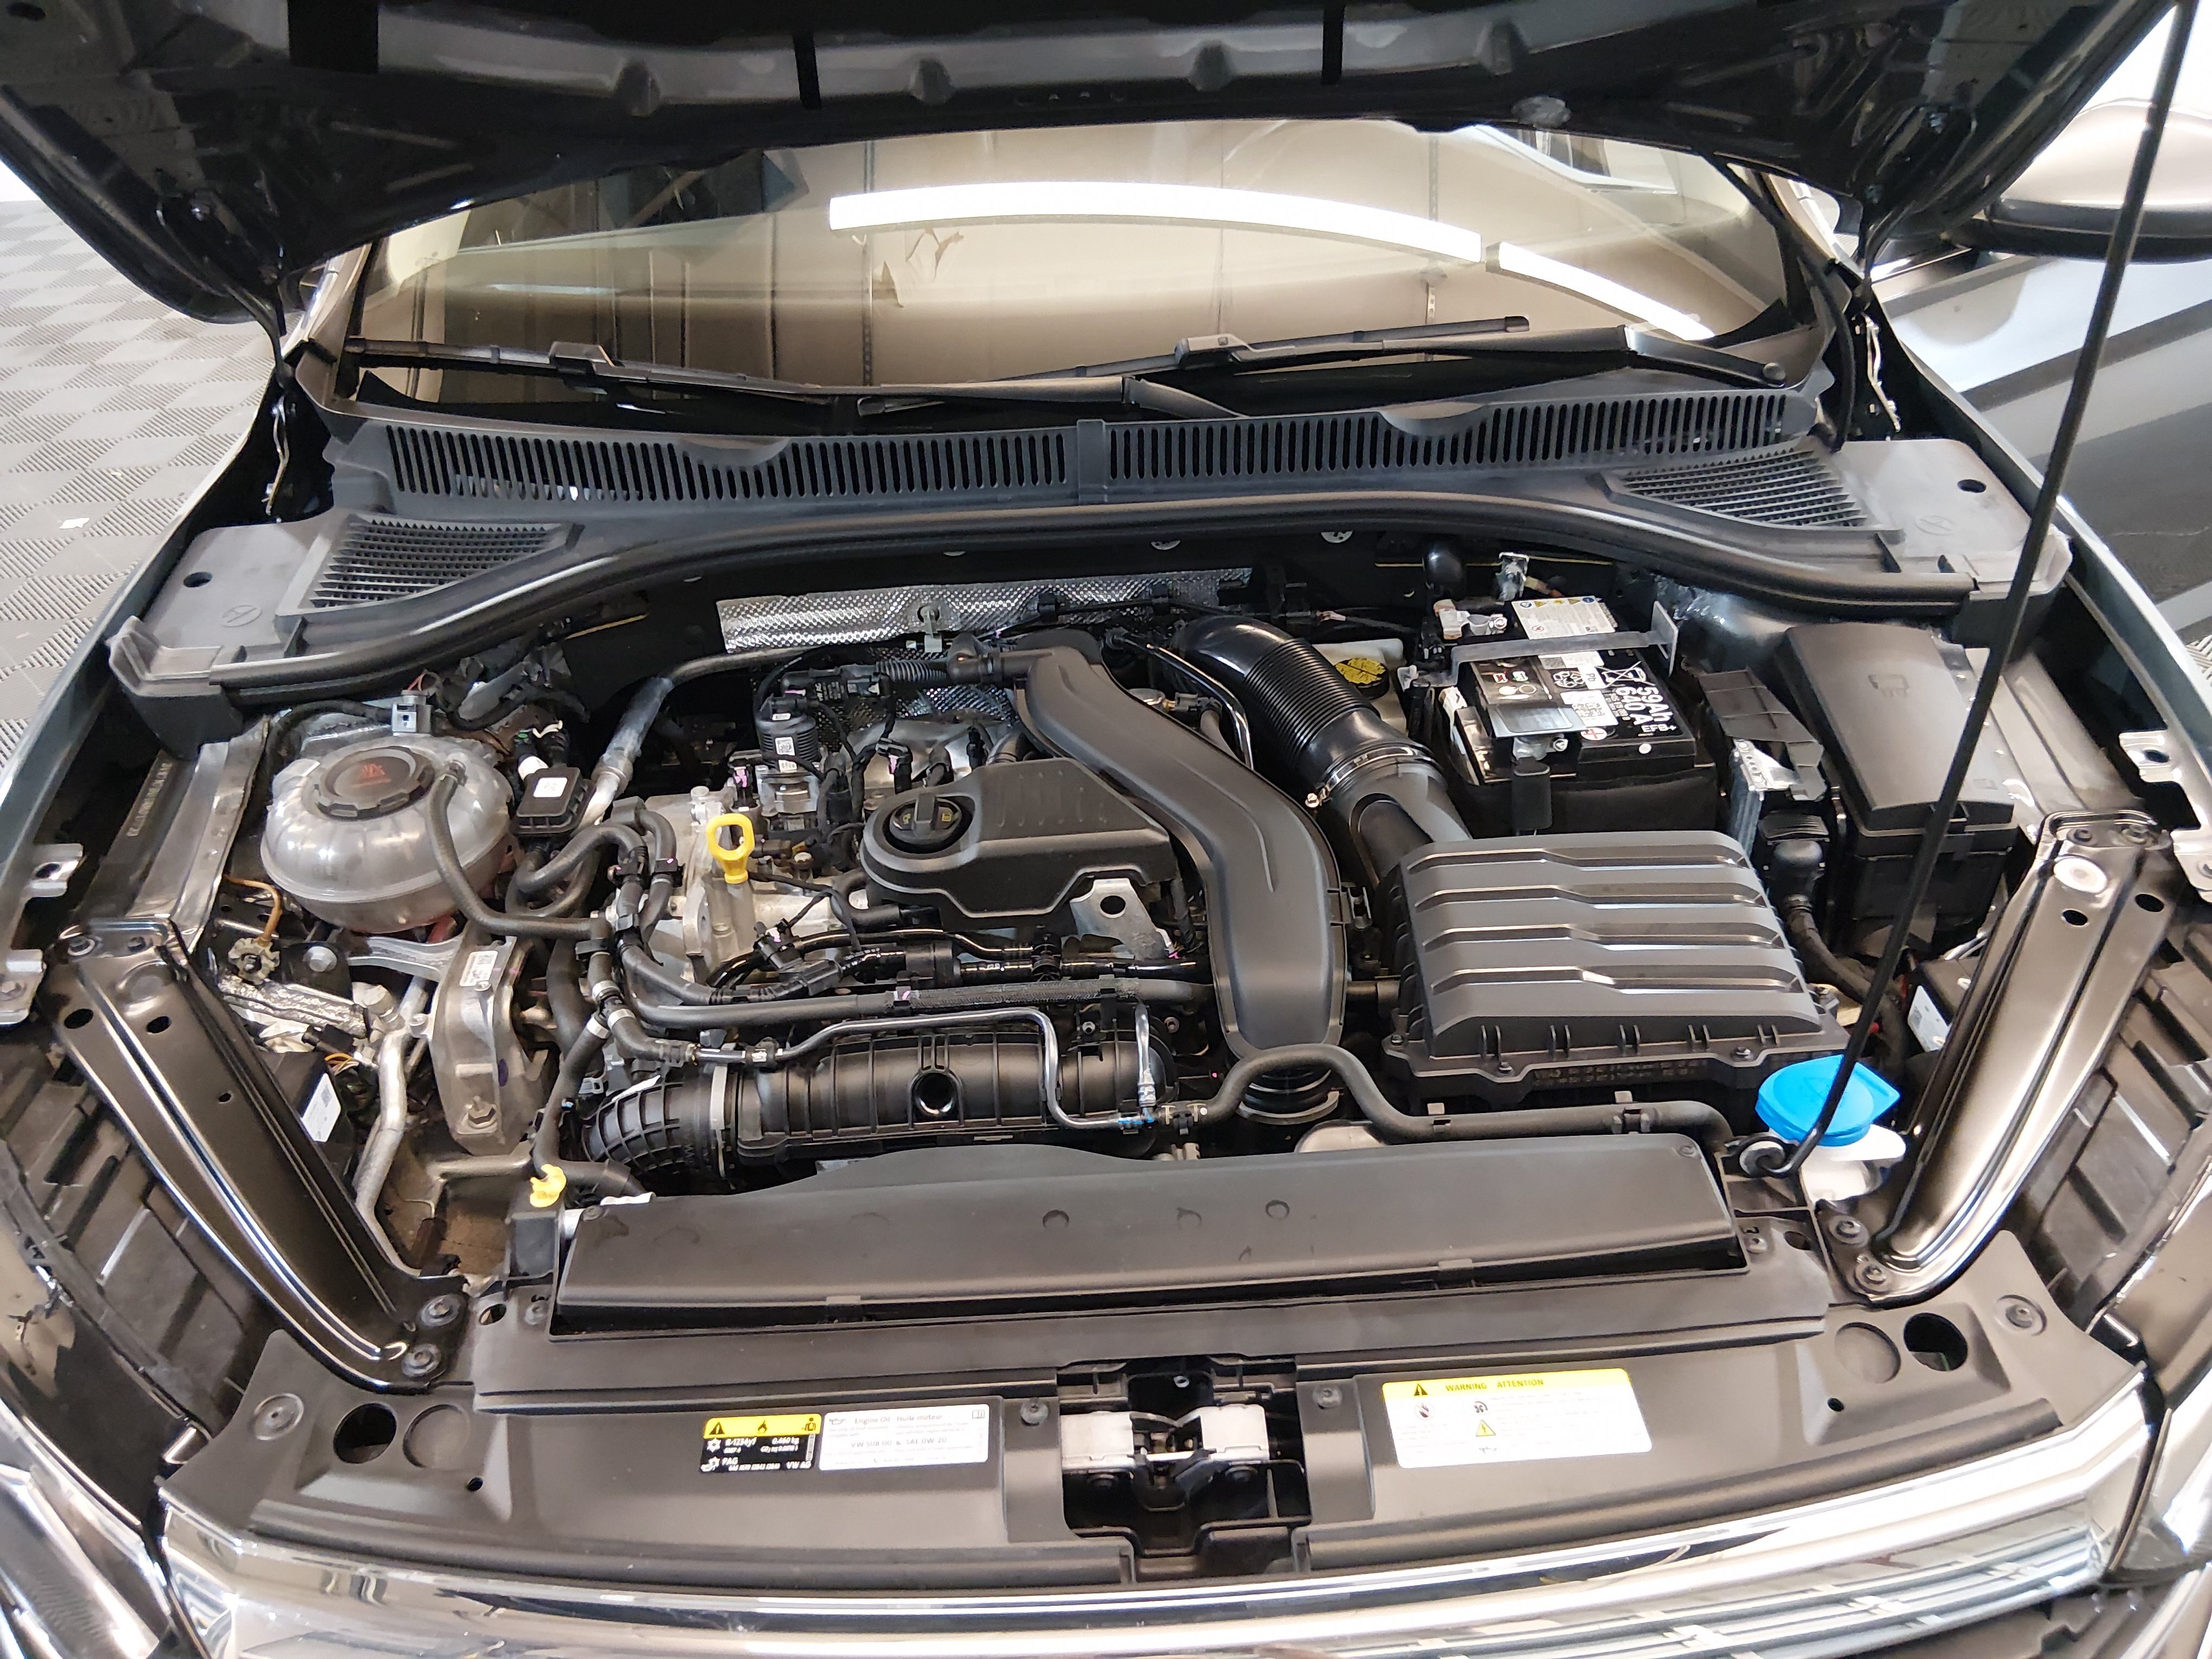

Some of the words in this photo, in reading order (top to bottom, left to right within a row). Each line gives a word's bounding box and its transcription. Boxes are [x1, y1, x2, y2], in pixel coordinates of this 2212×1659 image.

[1586, 673, 1596, 681] Pb
[1616, 686, 1646, 710] 640
[1637, 686, 1673, 722] 59Ah
[1629, 714, 1654, 725] A
[1444, 1382, 1487, 1392] WARNING
[1497, 1379, 1544, 1388] ATTENTION
[854, 1417, 878, 1425] Engine
